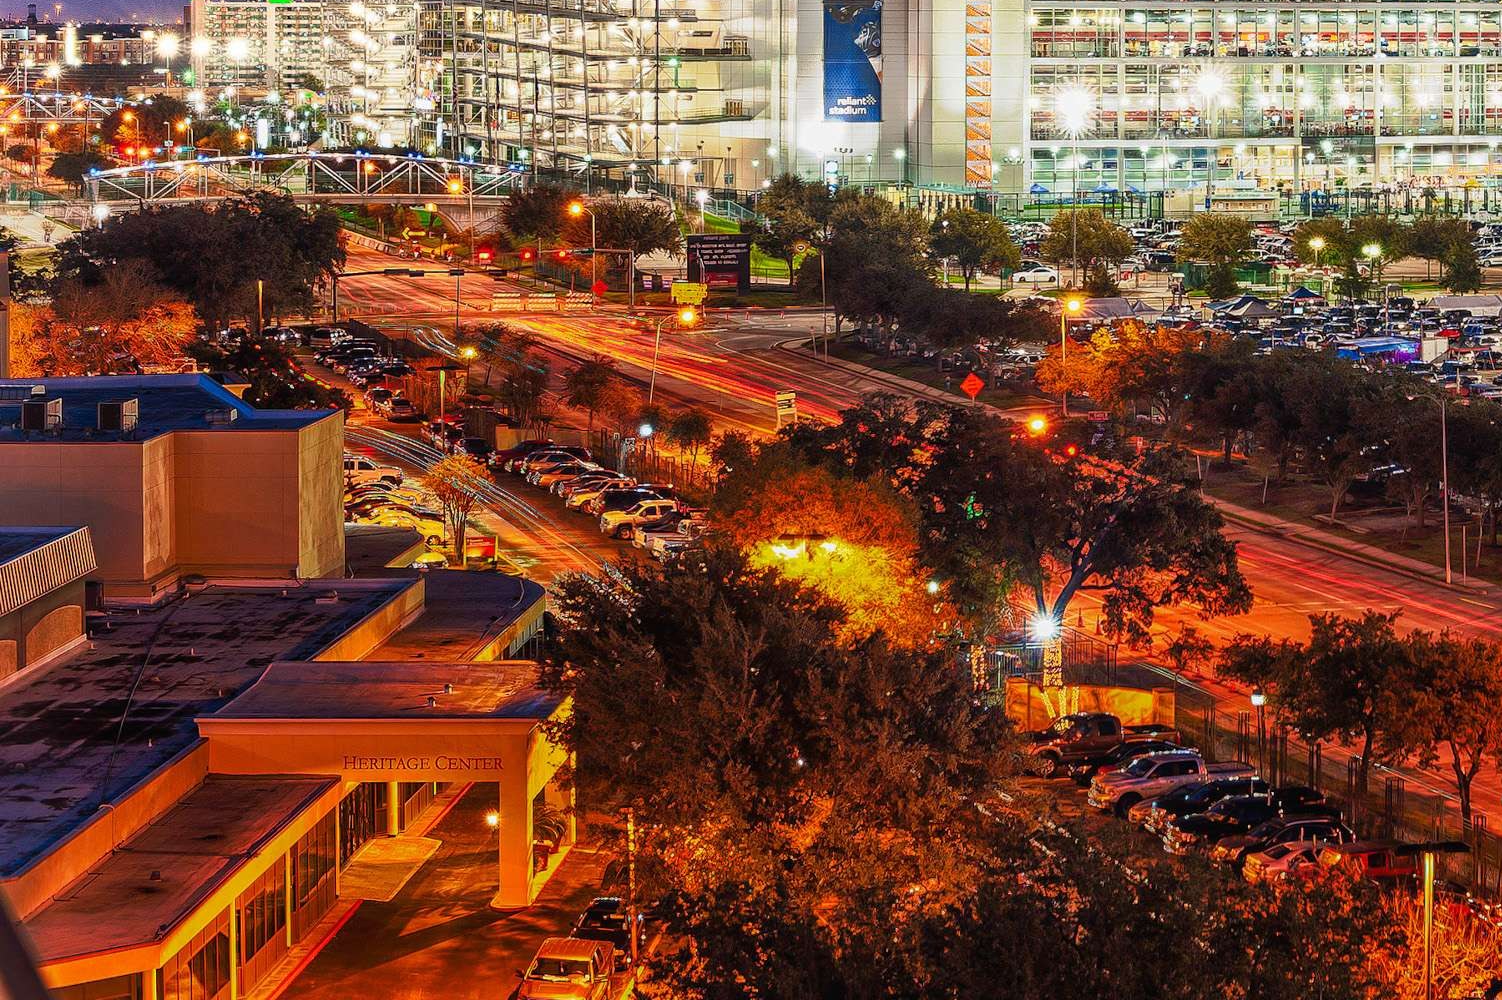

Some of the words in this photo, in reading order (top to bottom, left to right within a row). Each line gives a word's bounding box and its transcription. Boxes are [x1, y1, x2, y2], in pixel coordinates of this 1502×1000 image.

[837, 96, 867, 106] reliant
[829, 105, 867, 115] stadium
[343, 755, 431, 770] HERITAGE
[435, 755, 504, 770] CENTER
